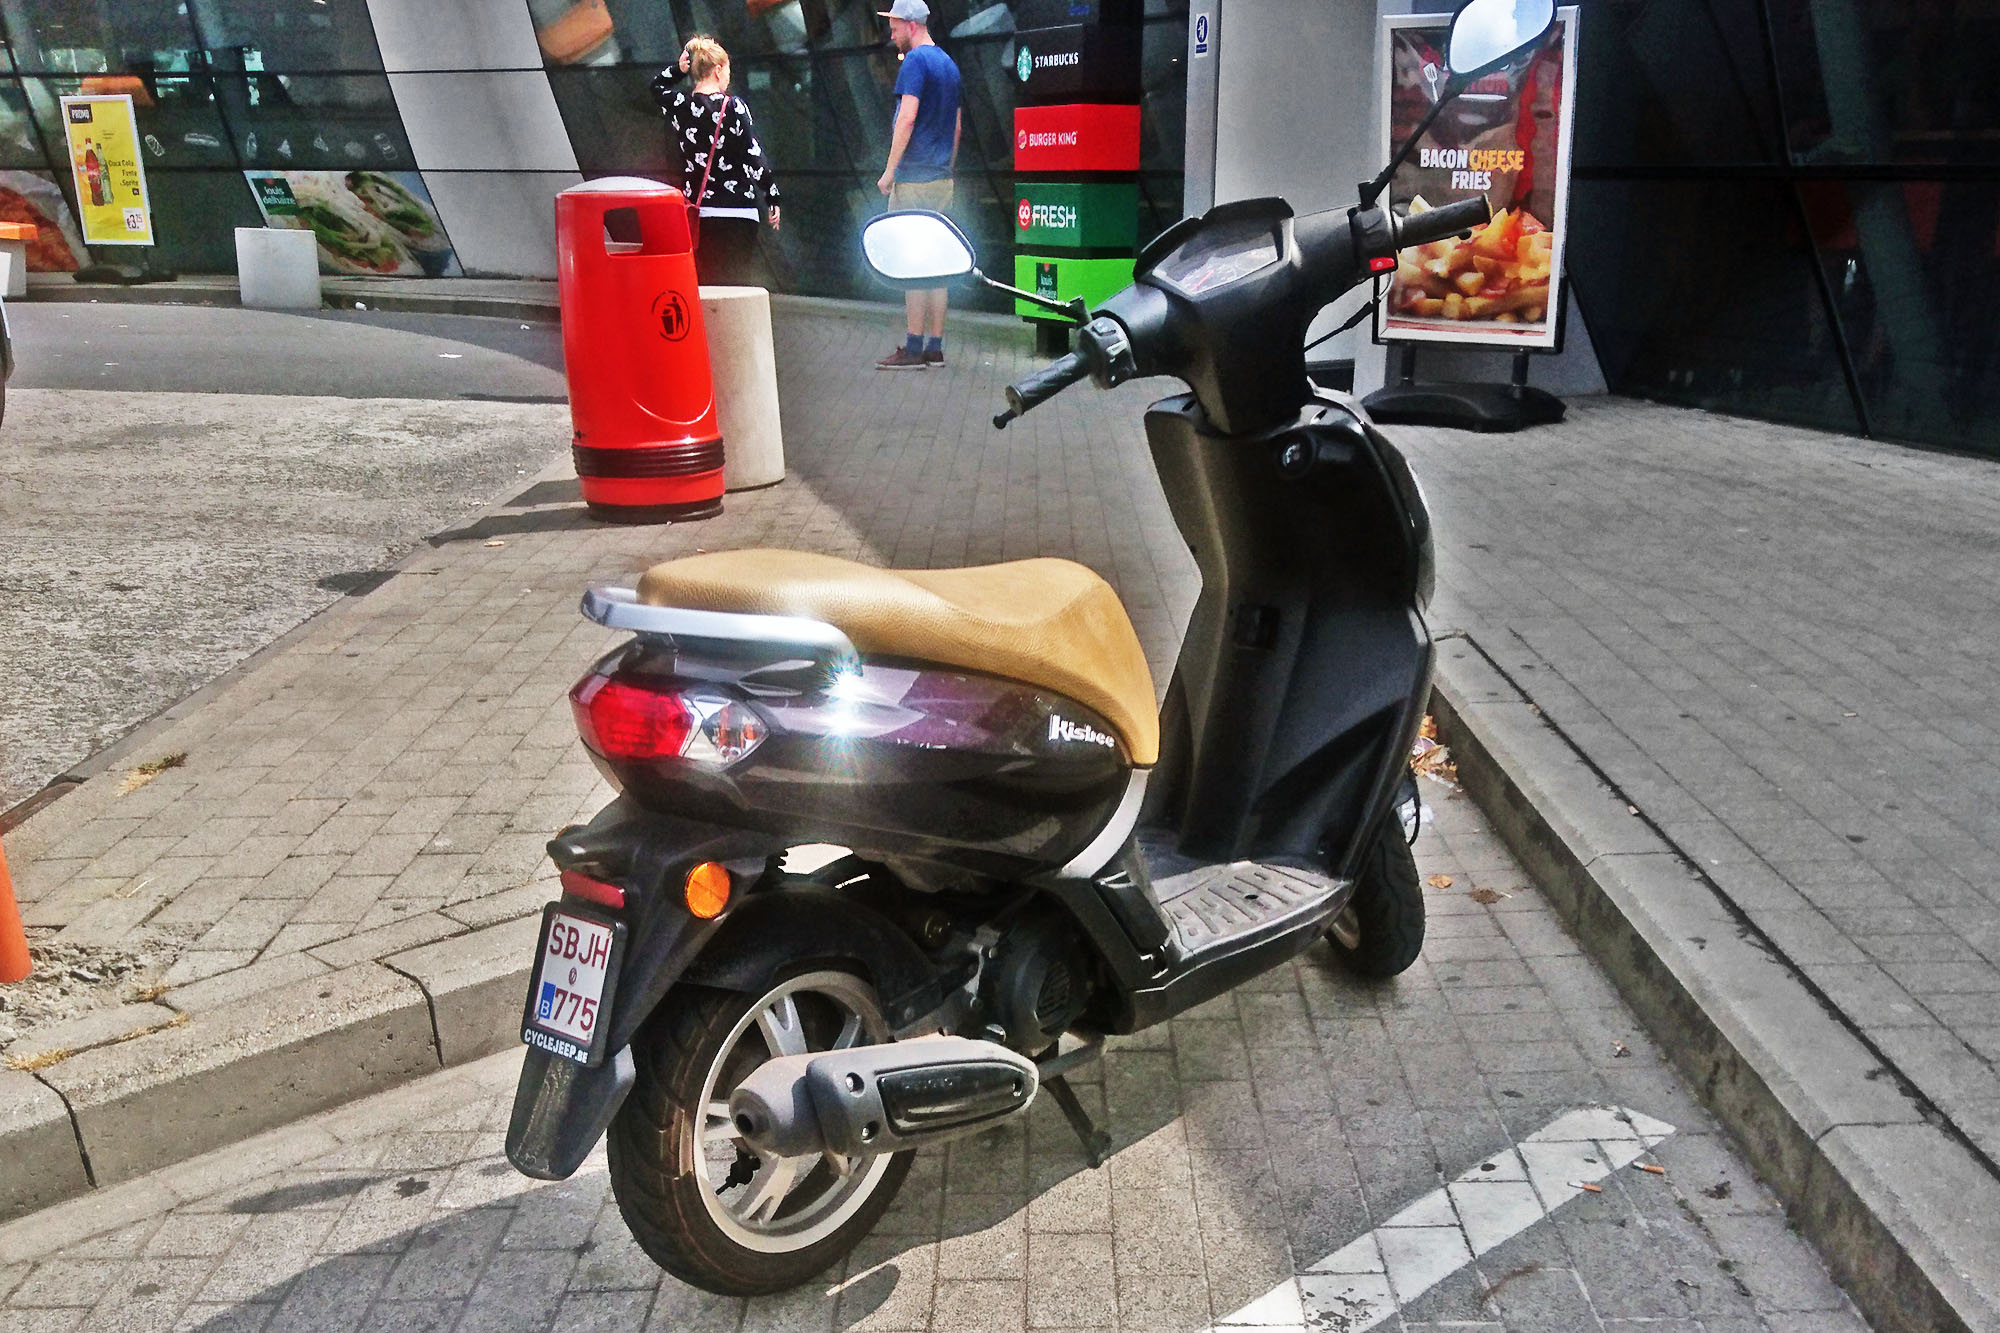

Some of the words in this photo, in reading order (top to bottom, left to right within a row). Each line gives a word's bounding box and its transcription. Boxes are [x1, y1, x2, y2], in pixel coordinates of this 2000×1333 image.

[1034, 52, 1079, 69] STARBUCKS
[71, 109, 90, 120] PROMO
[1029, 132, 1057, 147] BURGER
[1058, 131, 1077, 146] KING
[1420, 148, 1469, 169] BACON
[1469, 149, 1526, 173] CHEESE
[1451, 170, 1492, 190] FRIES
[1019, 205, 1031, 220] GO
[1031, 204, 1077, 229] FRESH
[1048, 713, 1115, 748] Kisbee
[549, 921, 611, 970] SBJH
[540, 1000, 551, 1017] B
[553, 987, 598, 1032] 775
[524, 1028, 589, 1064] CYCLEJEEP.BE
